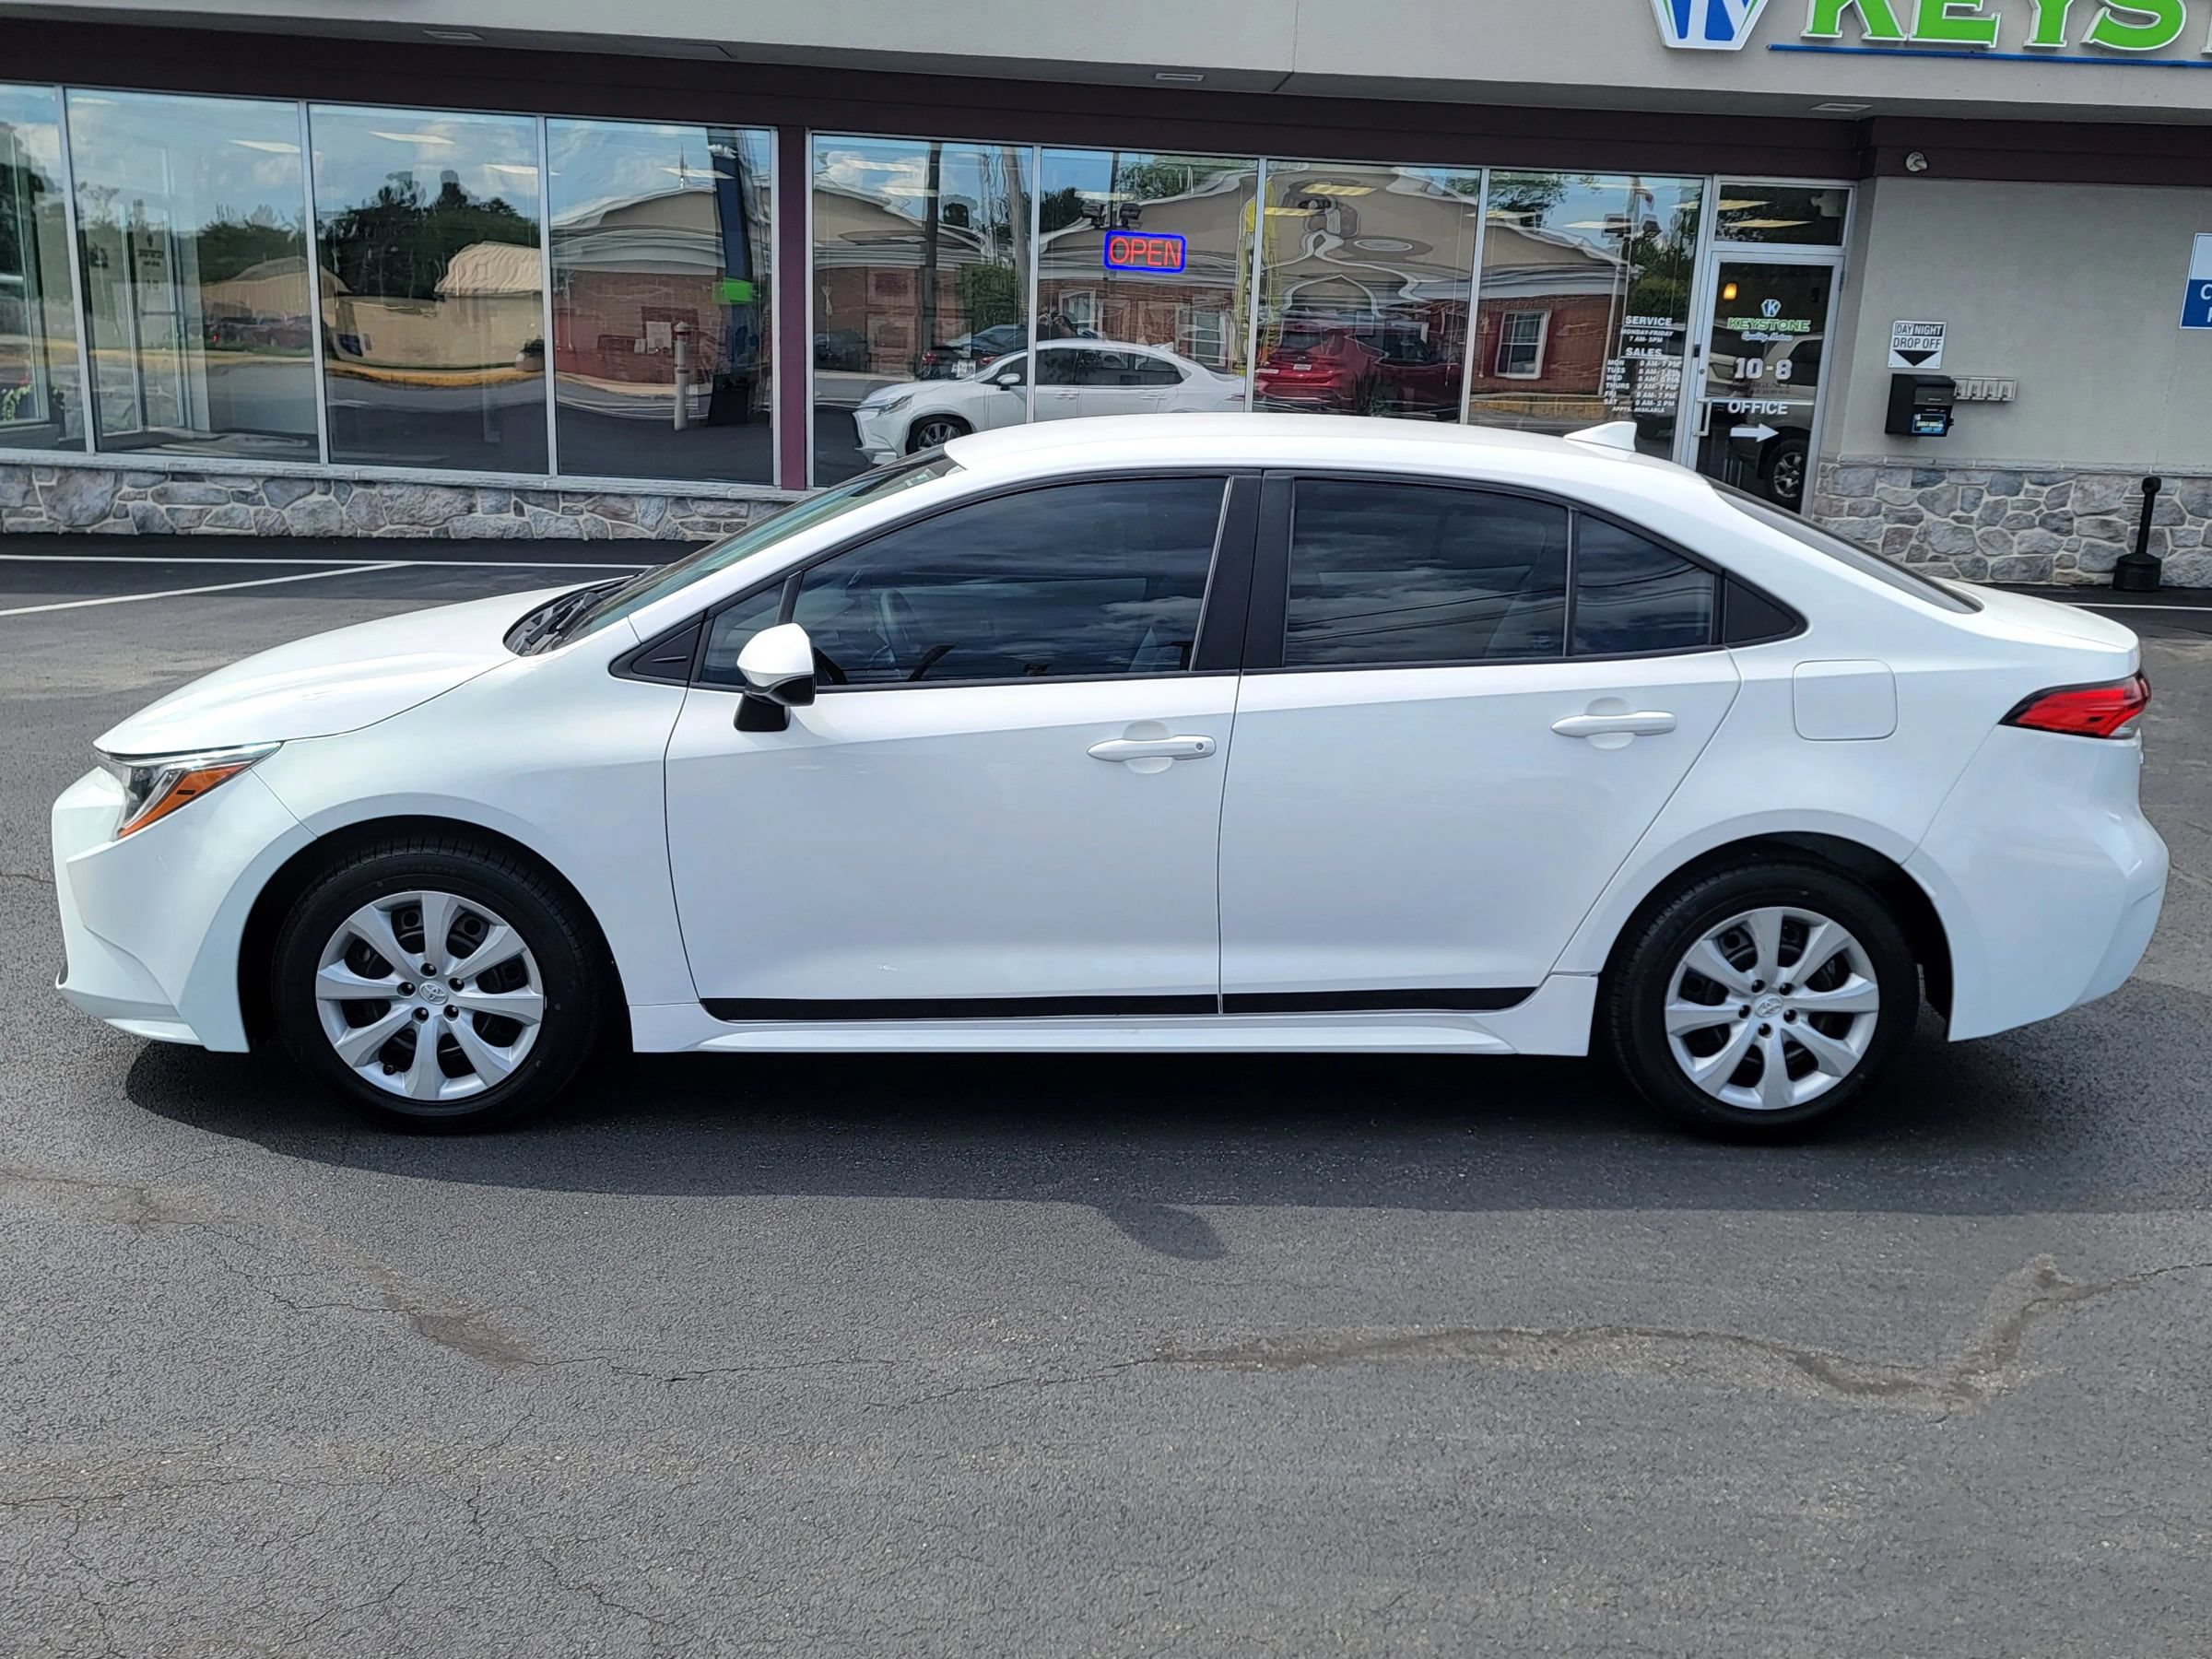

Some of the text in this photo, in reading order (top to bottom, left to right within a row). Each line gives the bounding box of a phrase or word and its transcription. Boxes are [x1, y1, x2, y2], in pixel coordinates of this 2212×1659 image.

[1800, 0, 2212, 54] KEYS
[1109, 236, 1182, 267] OPEN
[1625, 315, 1673, 326] SERVICE
[1727, 317, 1811, 332] KEYSTONE
[1621, 328, 1674, 336] MONDAY-FRIDAY
[1895, 324, 1943, 335] DAY NIGHT
[1892, 337, 1942, 349] DROP OFF
[1625, 347, 1663, 357] SALES
[1727, 400, 1788, 415] OFFICE
